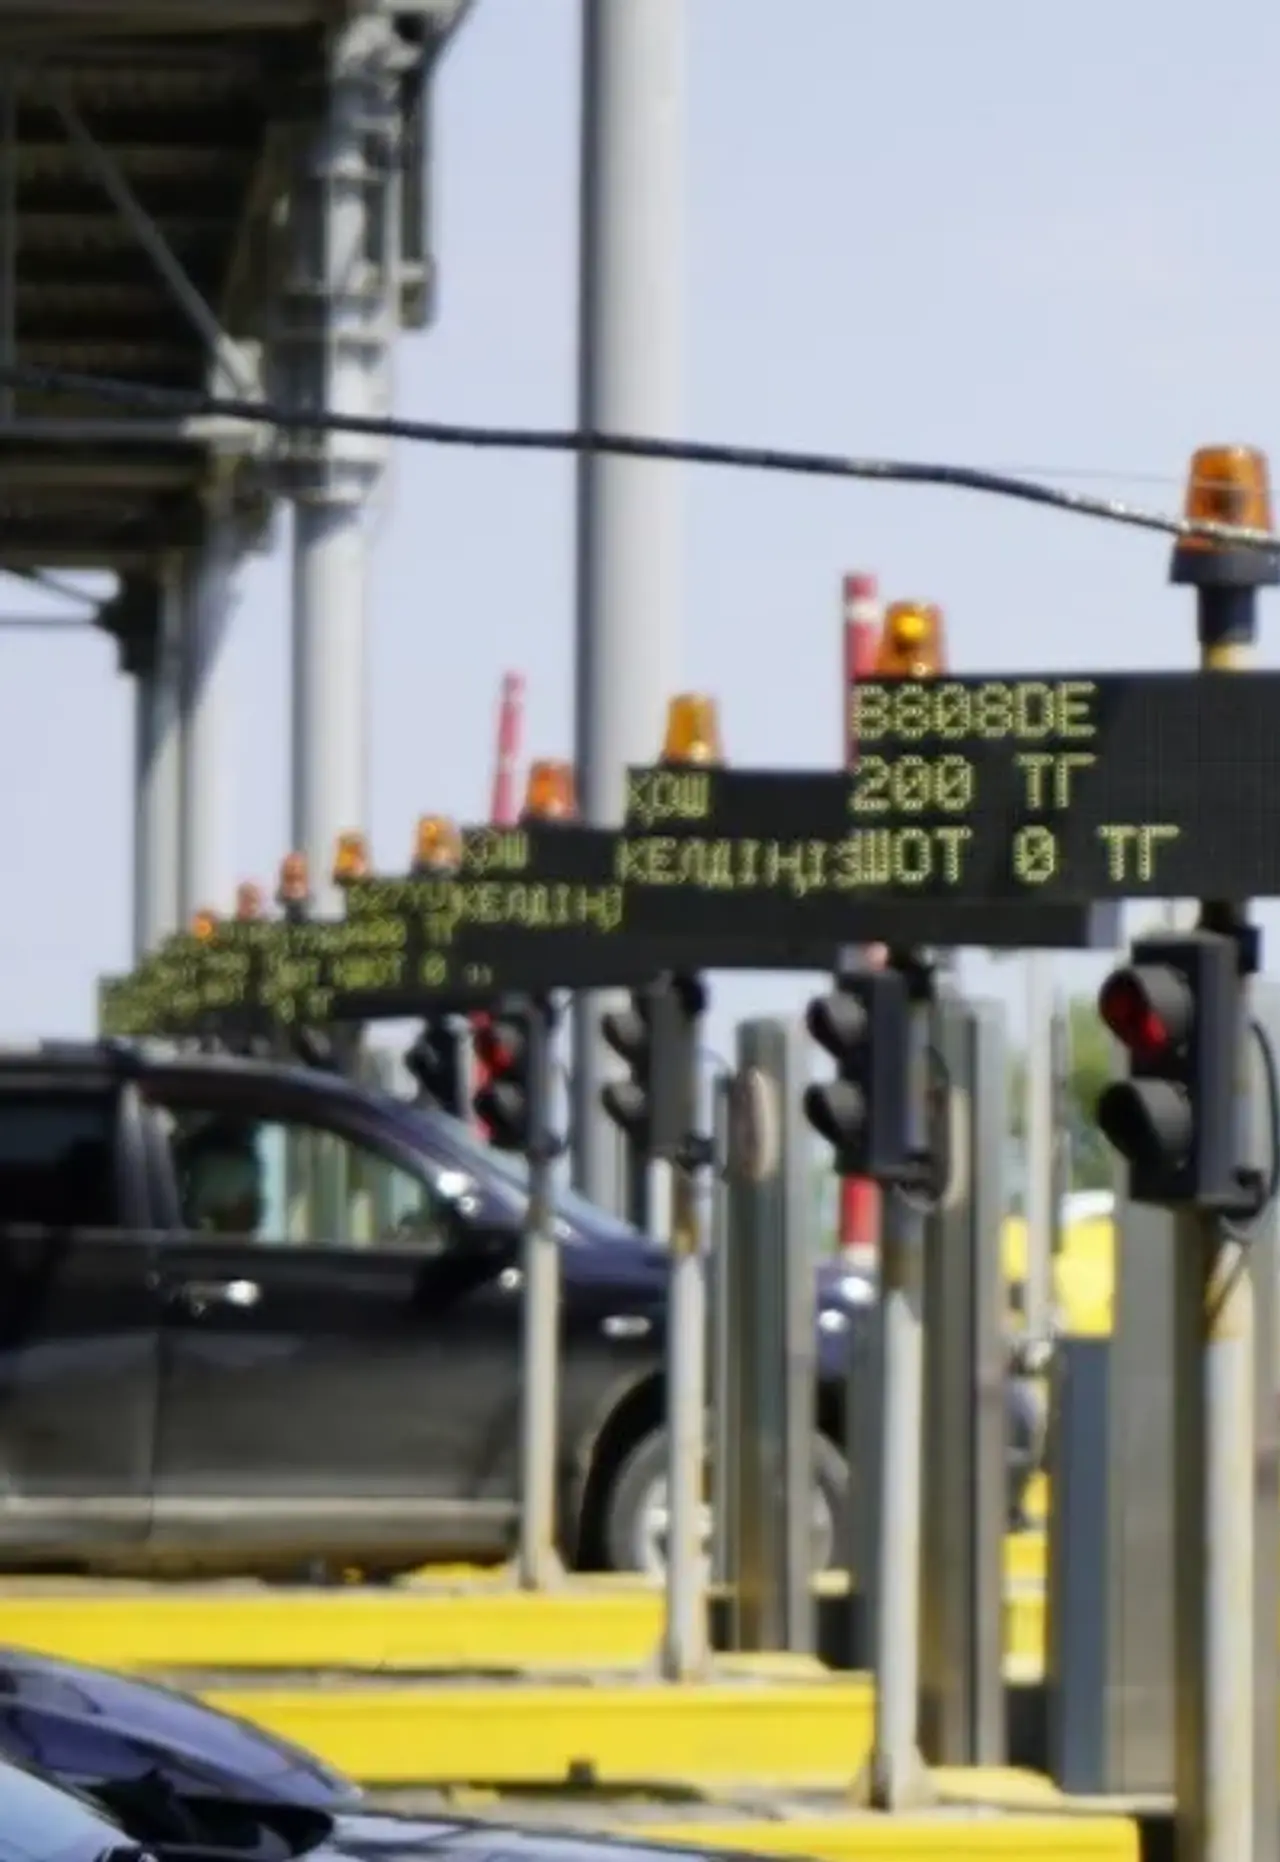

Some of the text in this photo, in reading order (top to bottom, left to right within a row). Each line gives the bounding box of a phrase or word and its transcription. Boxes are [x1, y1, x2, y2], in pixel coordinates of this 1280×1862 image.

[848, 752, 1098, 812] 200 ТГ
[850, 824, 1181, 885] ШОТ 0 ТГ
